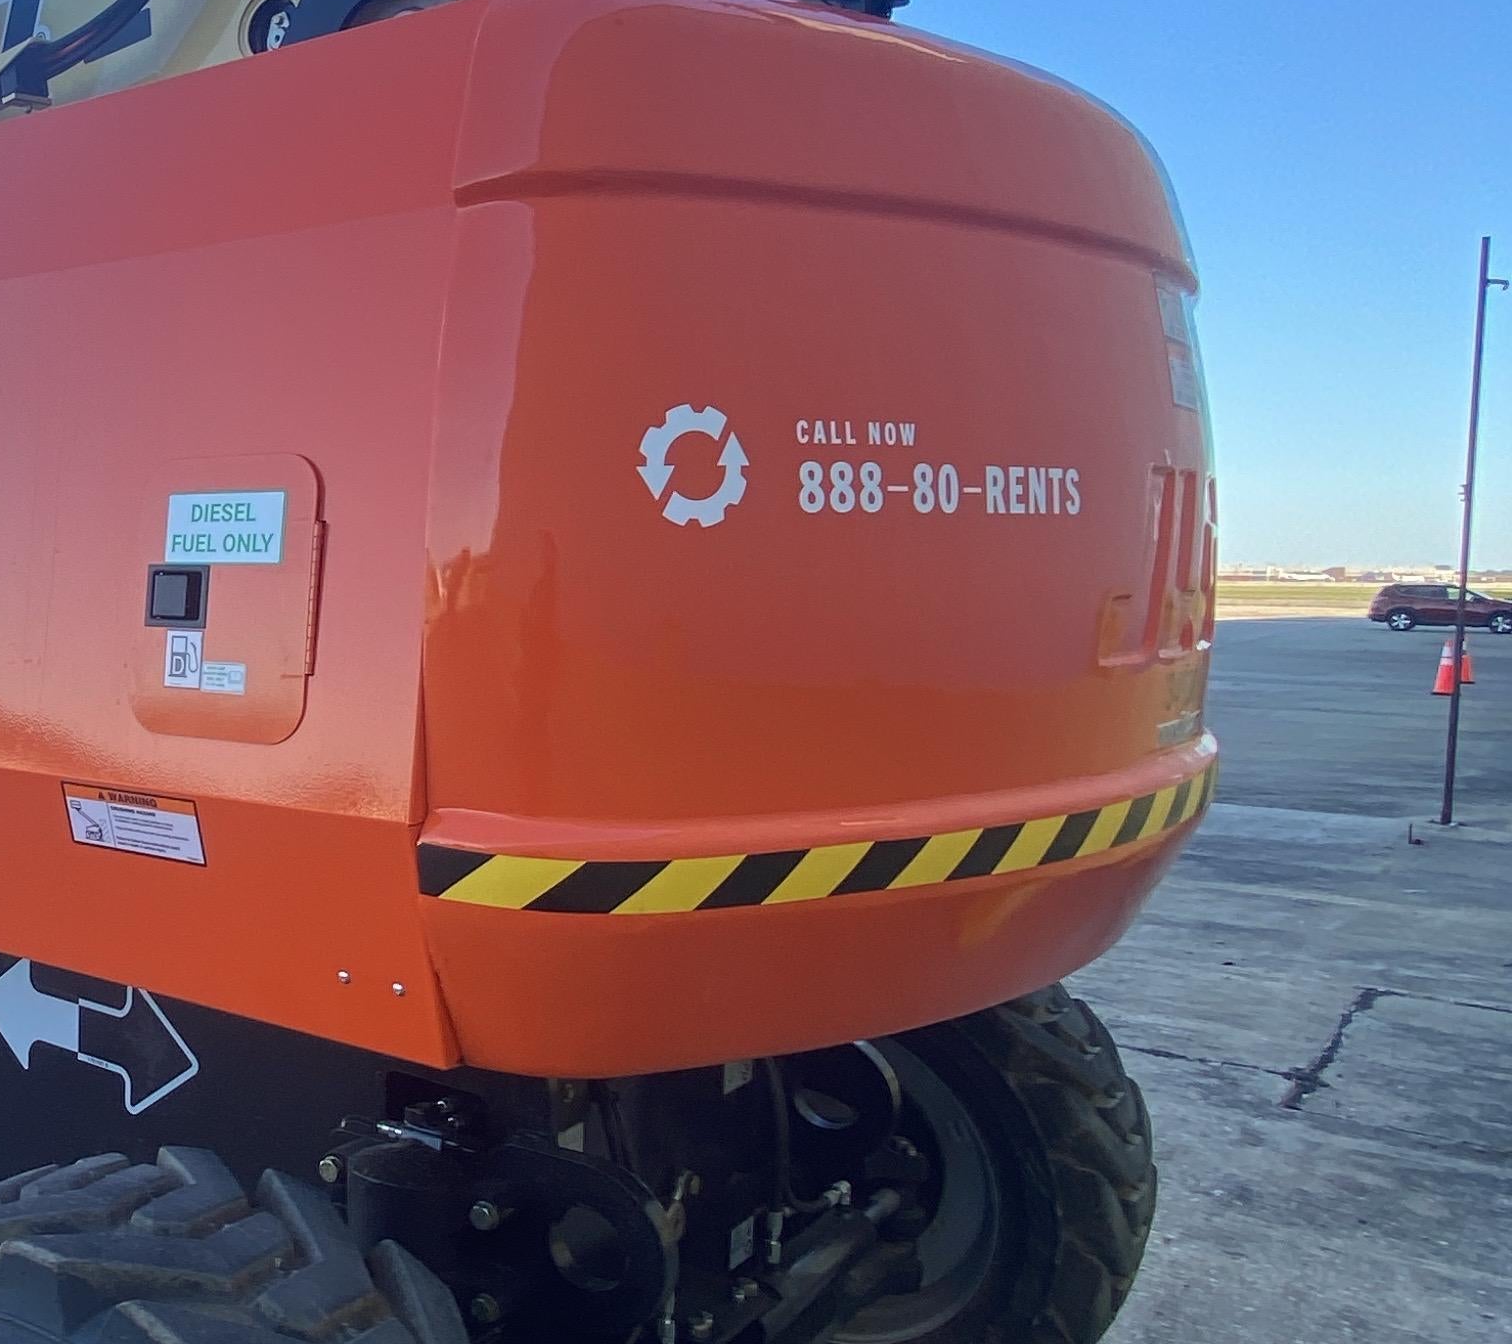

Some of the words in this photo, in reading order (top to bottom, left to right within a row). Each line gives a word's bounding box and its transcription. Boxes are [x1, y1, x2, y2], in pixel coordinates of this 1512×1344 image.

[796, 419, 857, 445] CALL
[868, 421, 916, 446] NOW
[798, 460, 1082, 515] 888-80-RENTS
[191, 502, 257, 523] DIESEL
[171, 533, 217, 553] FUEL
[222, 532, 274, 553] ONLY
[108, 792, 159, 808] WARNING
